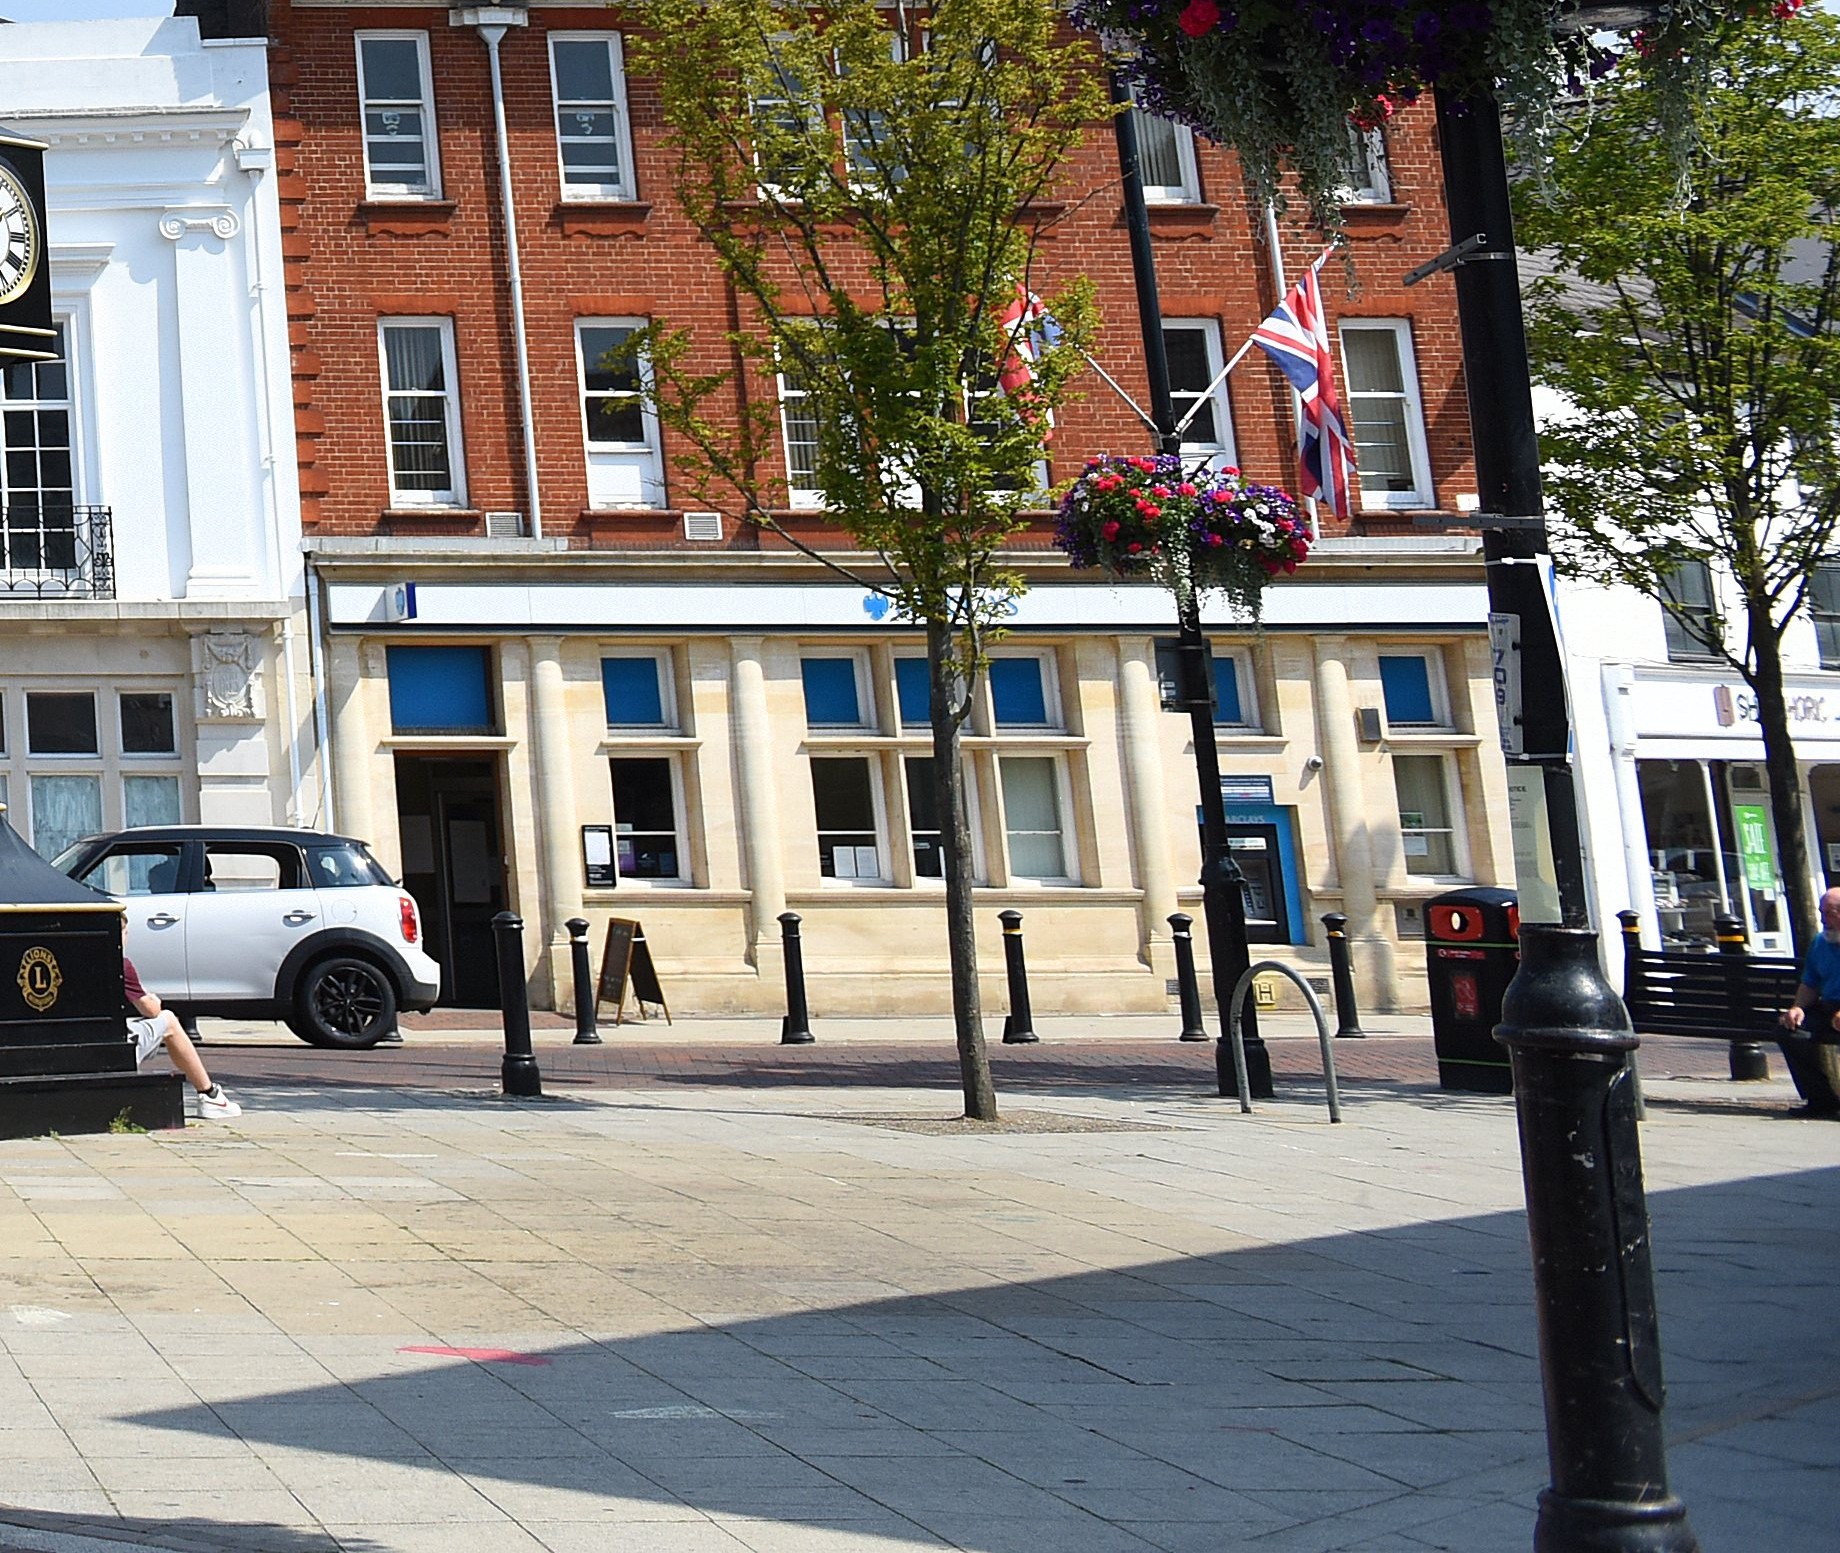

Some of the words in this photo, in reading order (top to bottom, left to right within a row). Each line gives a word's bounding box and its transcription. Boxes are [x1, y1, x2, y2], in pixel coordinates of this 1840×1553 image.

[1742, 822, 1767, 855] SALE
[25, 950, 52, 965] LIONS
[34, 967, 47, 988] L
